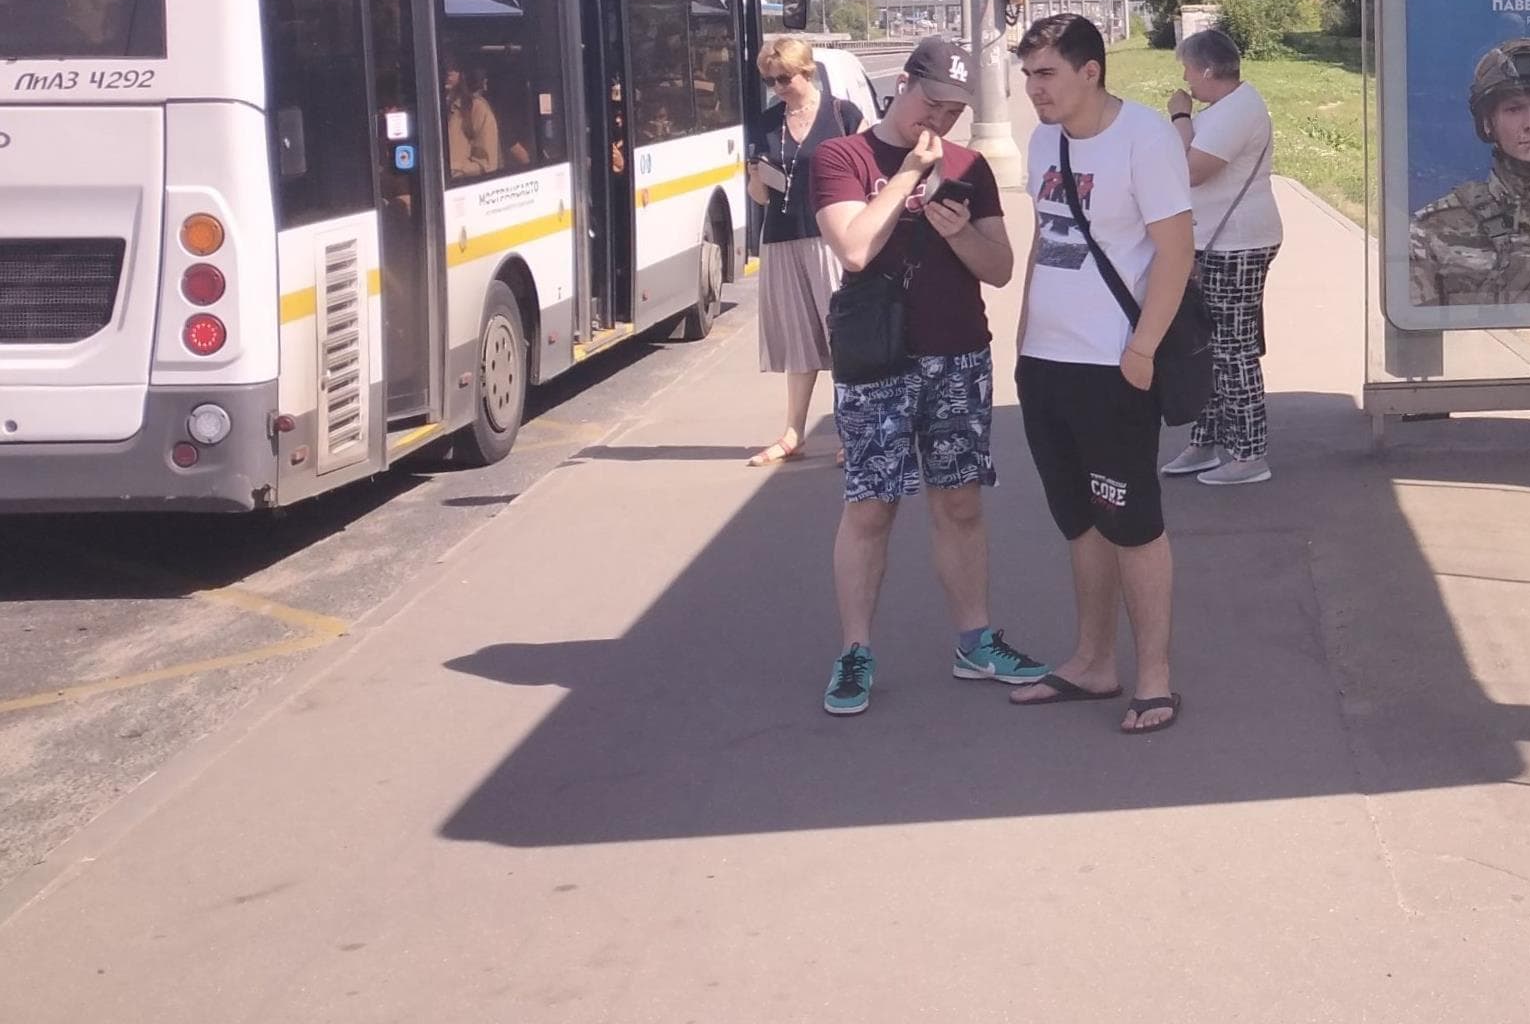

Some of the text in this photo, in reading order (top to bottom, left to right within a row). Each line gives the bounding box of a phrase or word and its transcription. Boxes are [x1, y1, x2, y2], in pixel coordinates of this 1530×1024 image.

[89, 69, 155, 89] 4292
[949, 55, 969, 83] LA
[1090, 479, 1127, 506] CORE
